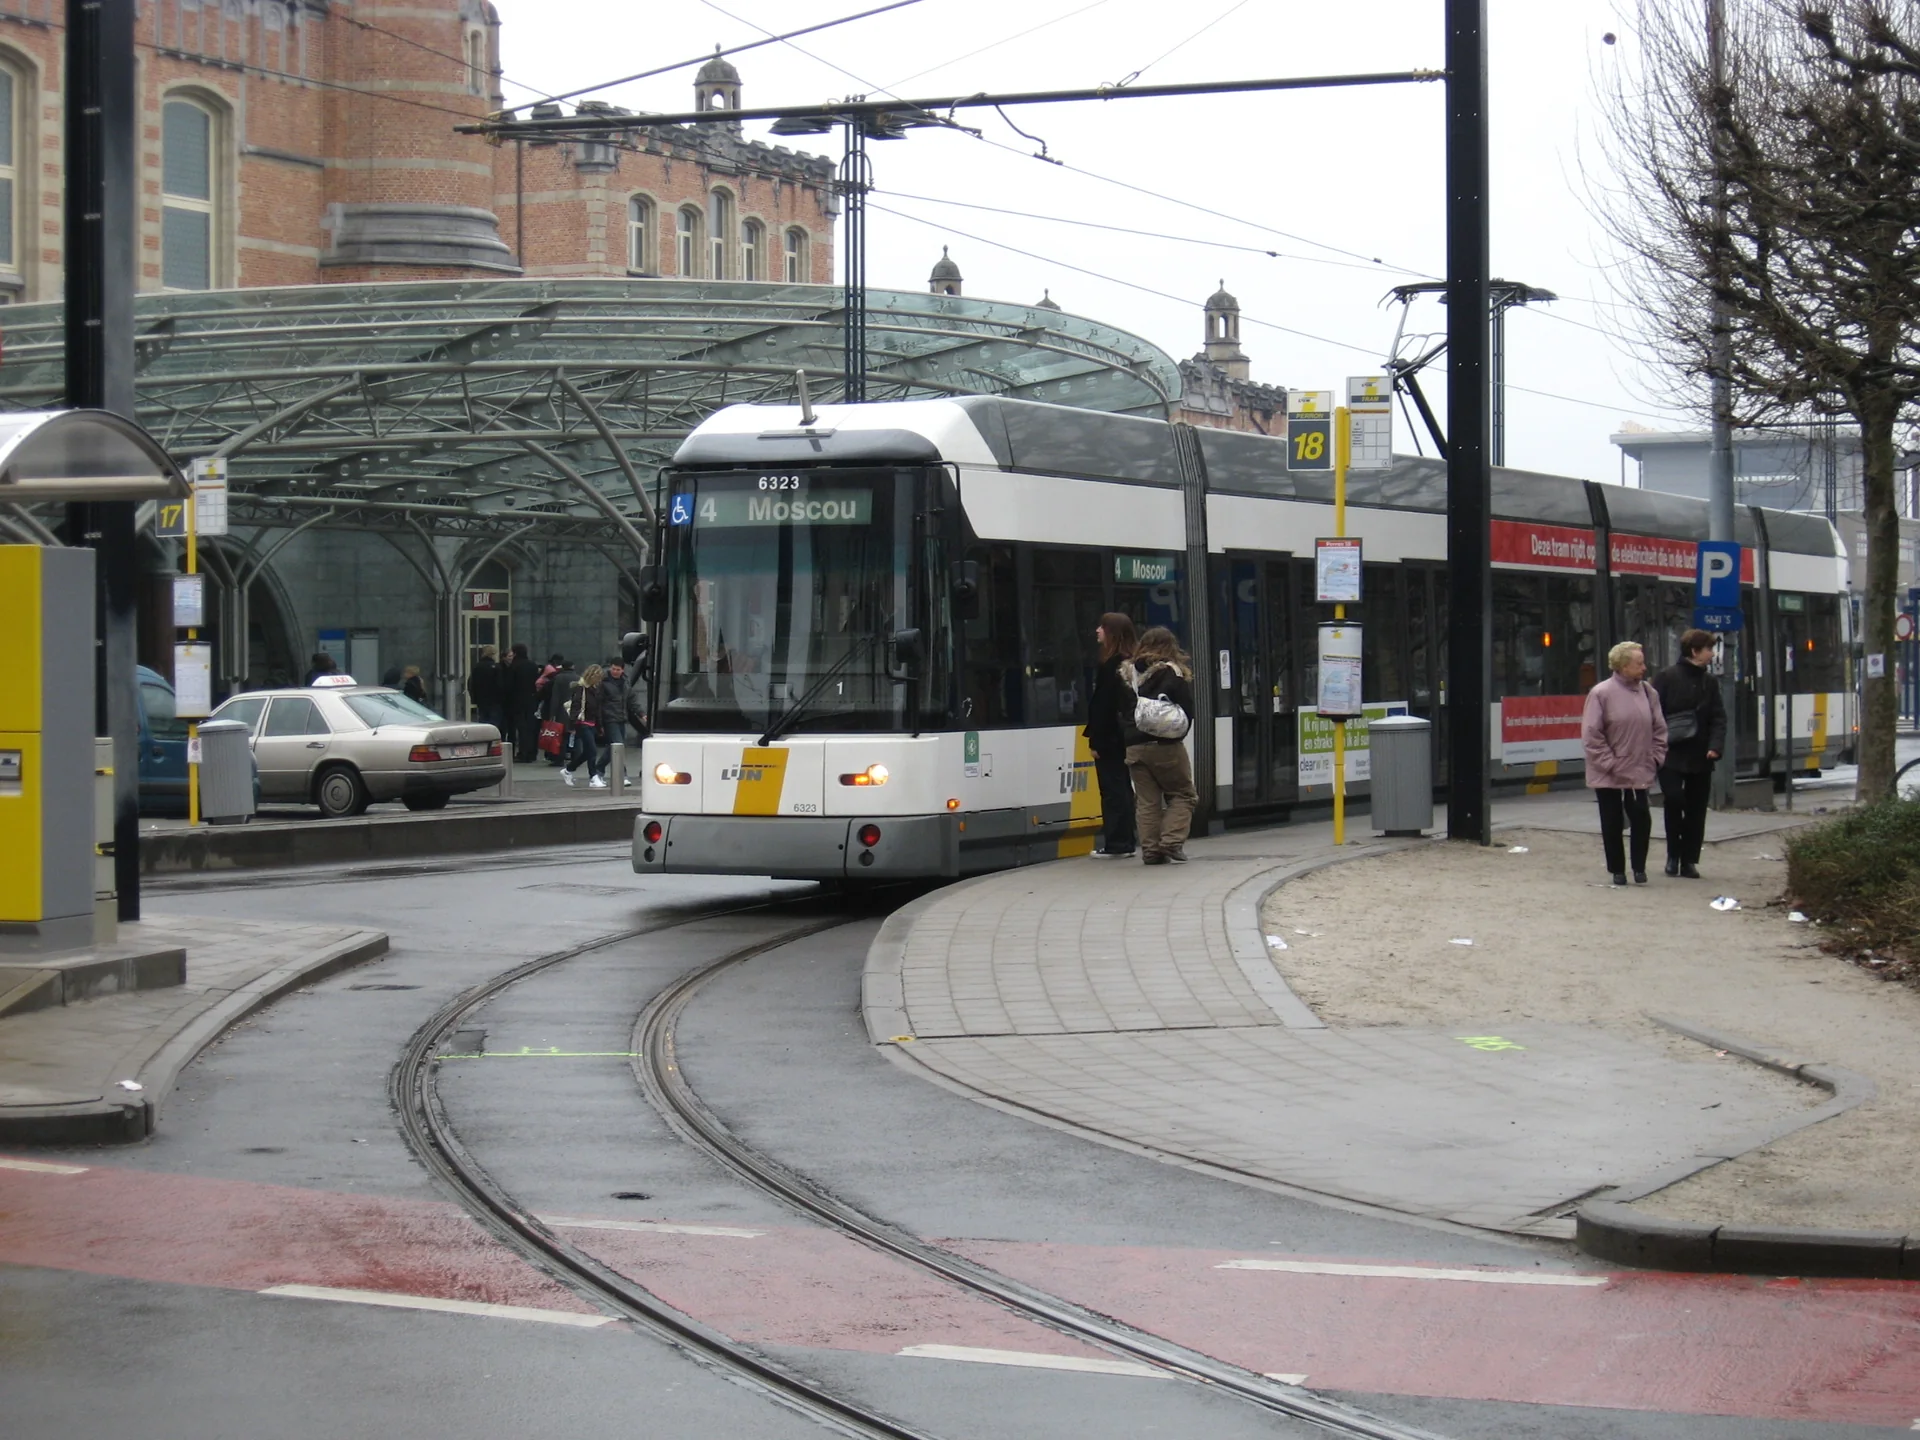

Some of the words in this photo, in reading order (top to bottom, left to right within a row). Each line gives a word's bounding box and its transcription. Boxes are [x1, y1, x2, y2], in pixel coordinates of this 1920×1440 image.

[1294, 432, 1325, 460] 18
[758, 476, 800, 490] 6323
[160, 504, 182, 528] 17
[700, 498, 717, 522] 4
[748, 497, 856, 521] Moscou
[1115, 558, 1121, 579] 4
[1132, 559, 1166, 580] Moscou
[1702, 551, 1733, 596] P
[473, 592, 490, 607] RELAY
[836, 681, 843, 695] 1
[793, 803, 817, 813] 6323
